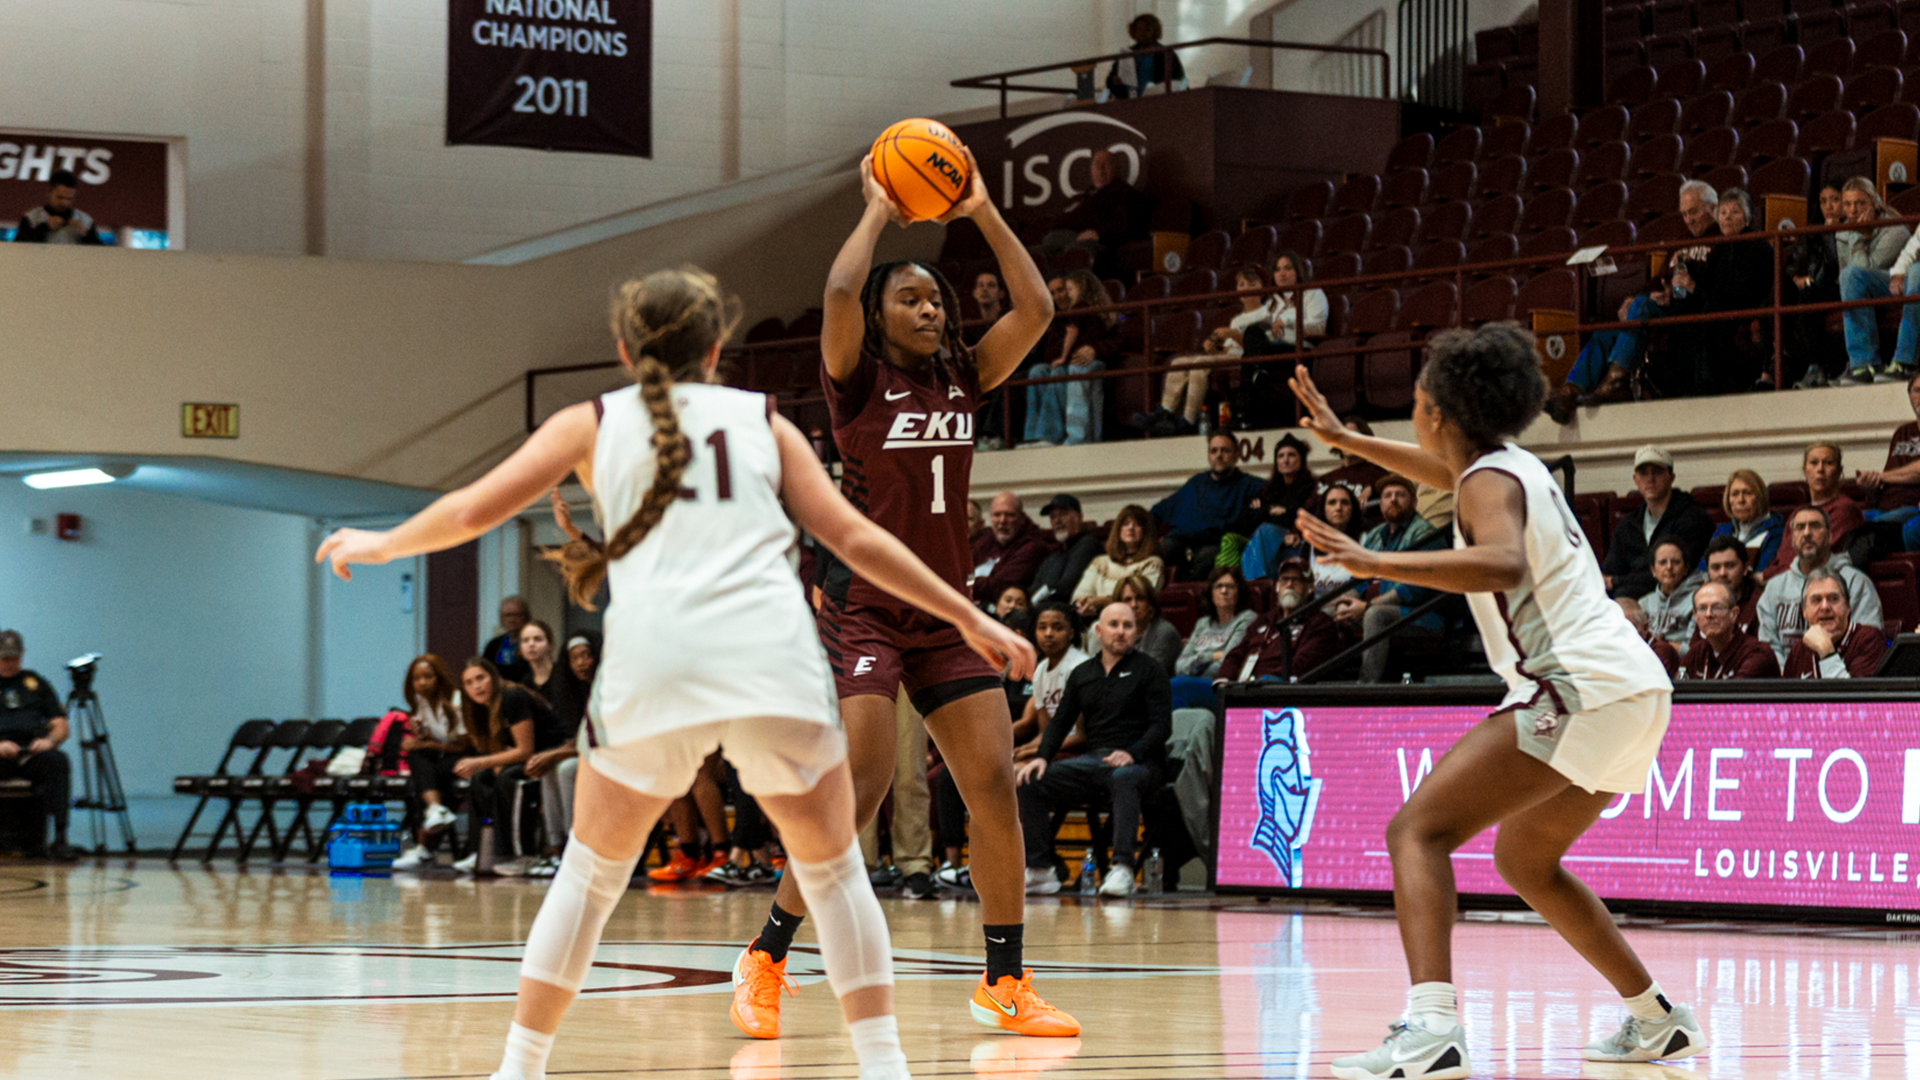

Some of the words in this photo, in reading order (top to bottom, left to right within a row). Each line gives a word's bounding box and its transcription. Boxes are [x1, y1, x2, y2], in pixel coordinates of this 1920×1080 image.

[485, 0, 617, 25] NATIONAL
[472, 20, 628, 57] CHAMPIONS
[513, 75, 588, 117] 2011
[926, 151, 963, 190] NCAA
[192, 405, 231, 434] EXIT
[886, 411, 973, 440] EKU
[931, 454, 946, 514] 1
[854, 656, 877, 672] E
[1774, 747, 1869, 823] TO
